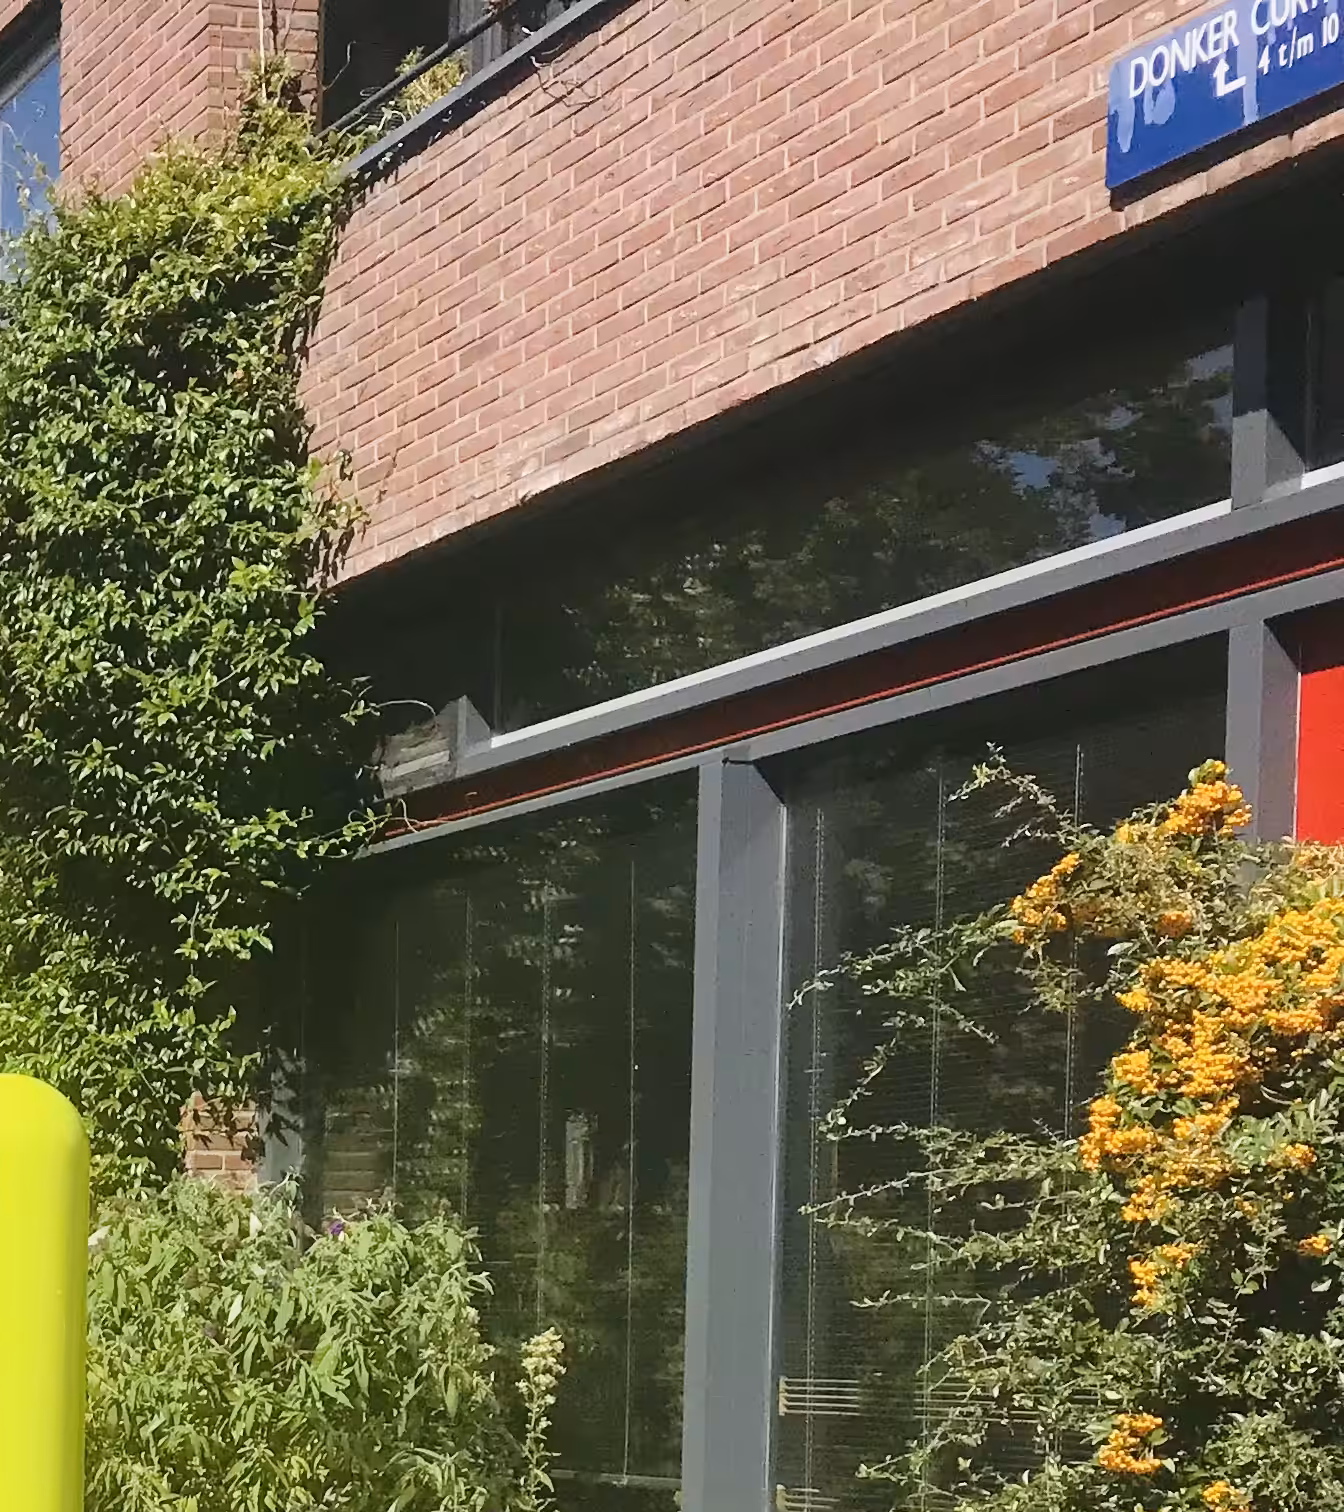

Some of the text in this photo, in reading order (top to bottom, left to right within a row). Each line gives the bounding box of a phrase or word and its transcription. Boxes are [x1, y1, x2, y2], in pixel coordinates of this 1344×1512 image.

[1129, 9, 1240, 99] DONKER
[1258, 12, 1340, 75] 4 t/m 10
